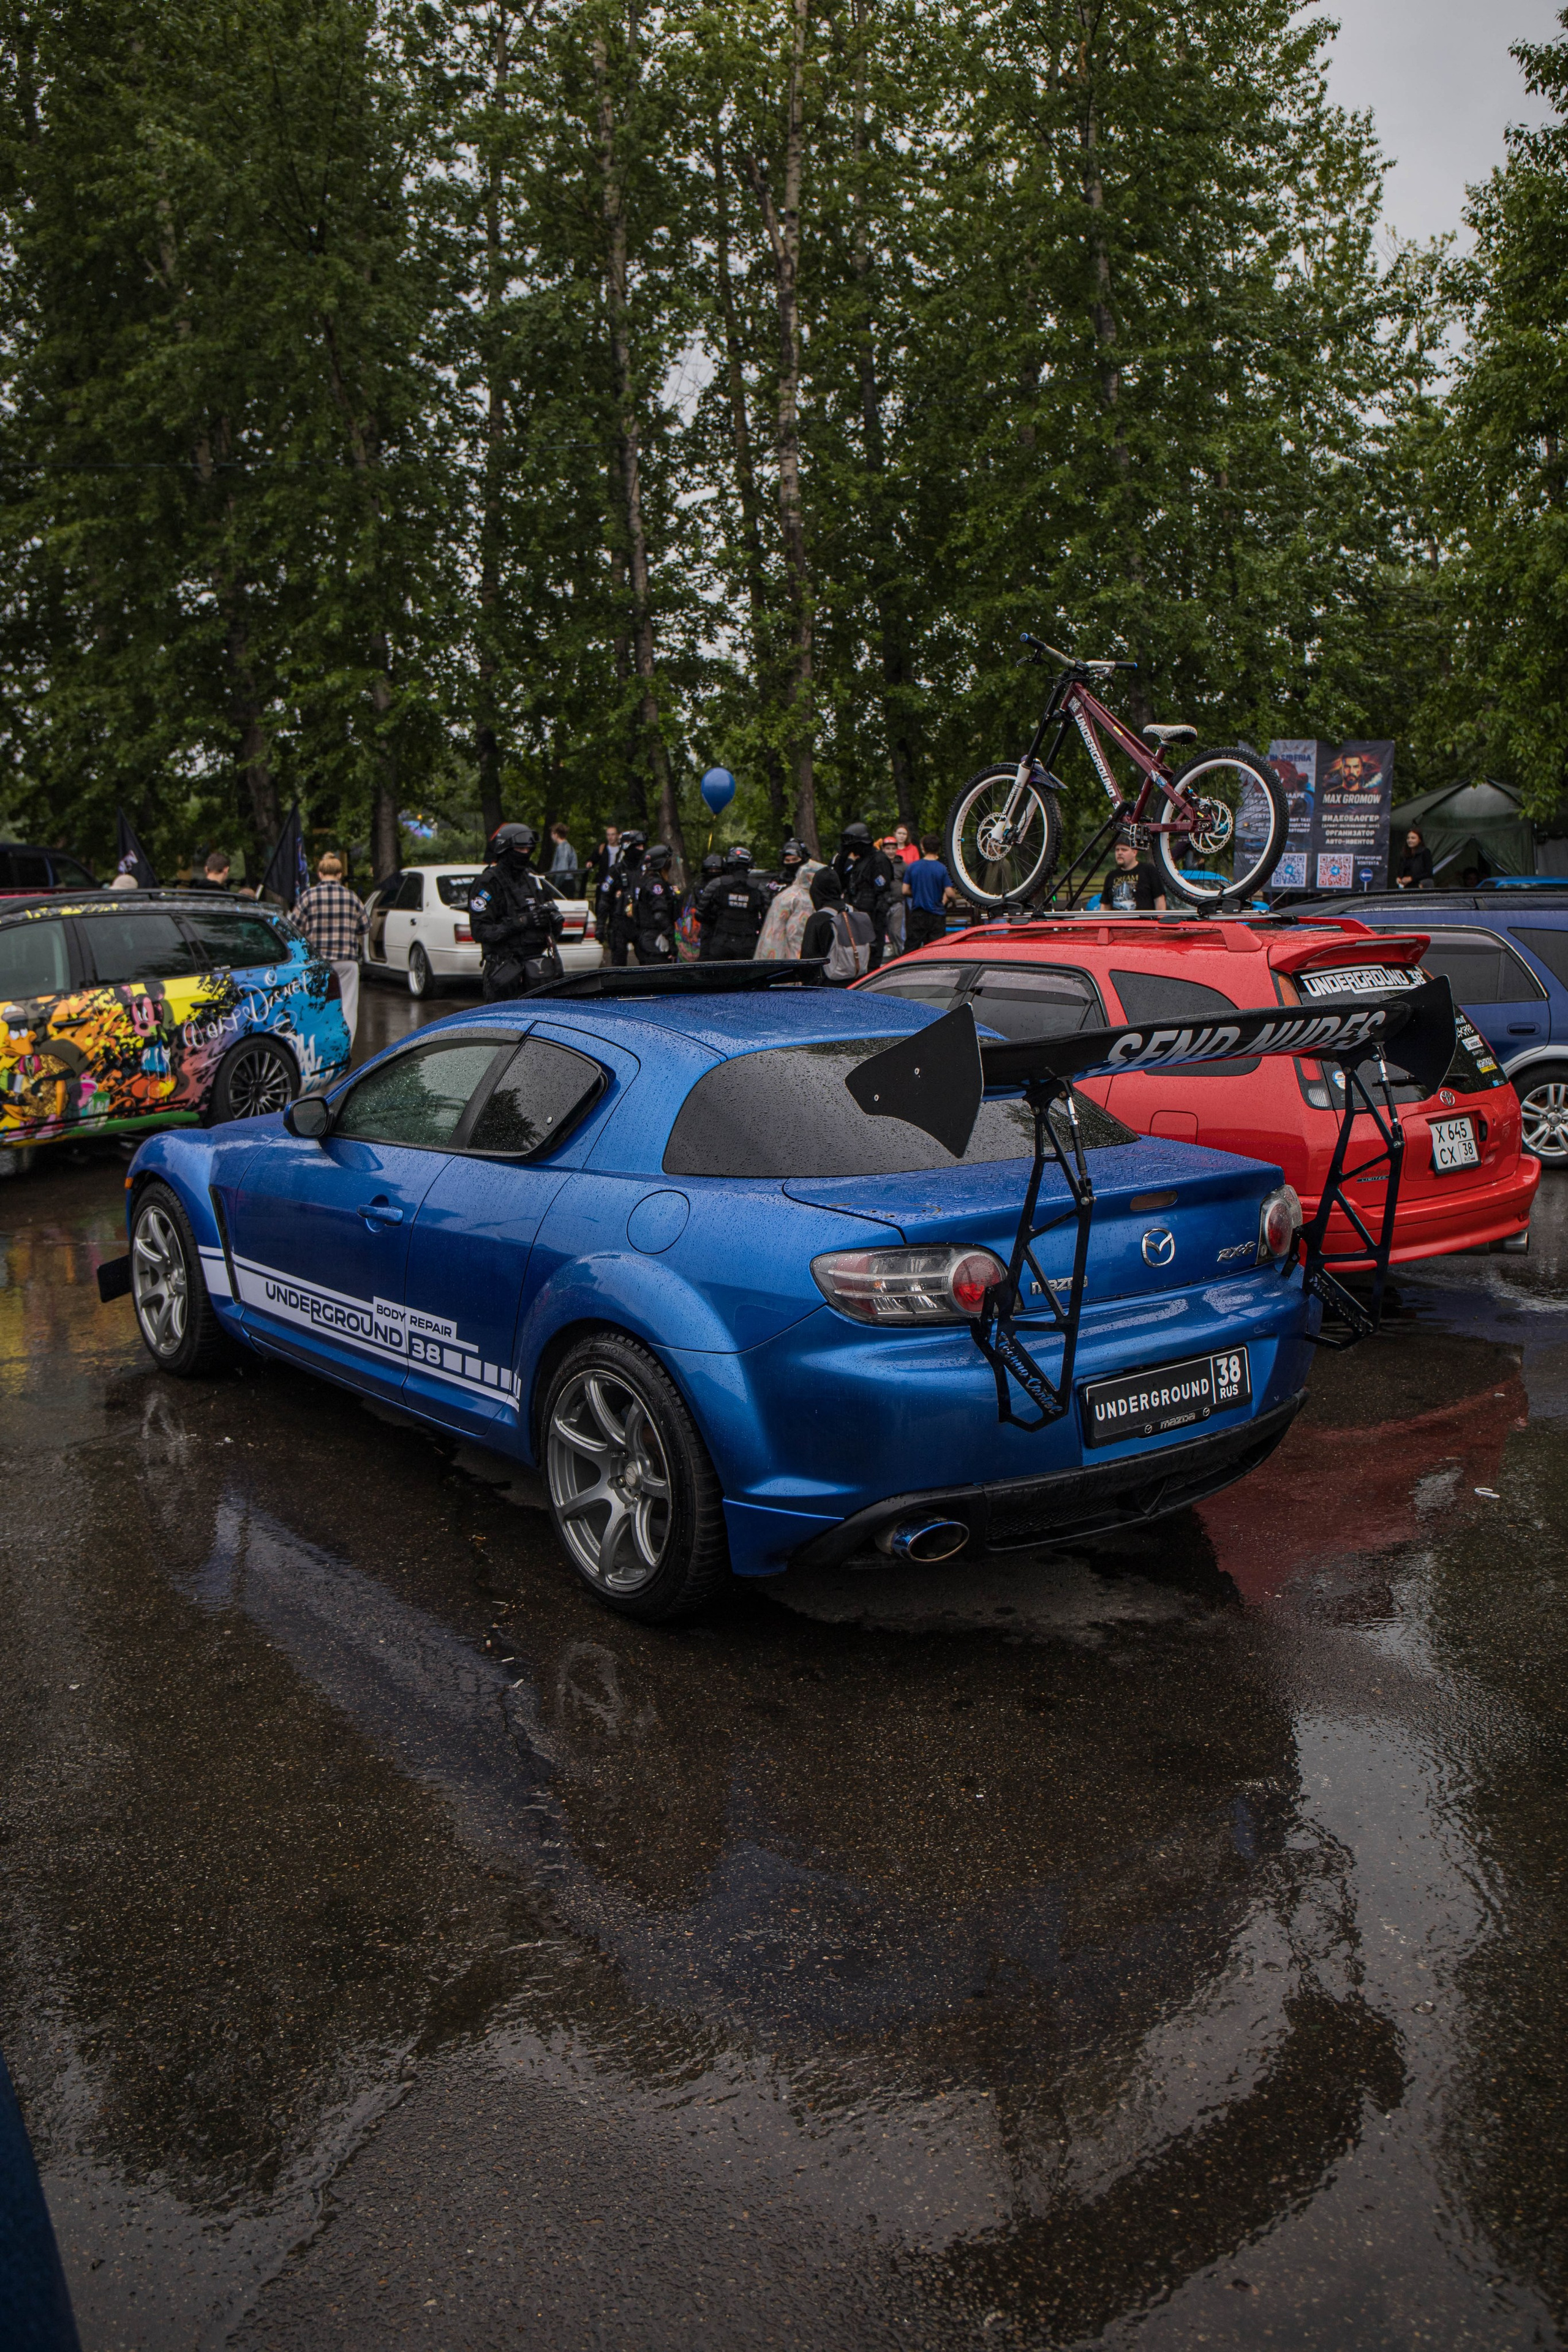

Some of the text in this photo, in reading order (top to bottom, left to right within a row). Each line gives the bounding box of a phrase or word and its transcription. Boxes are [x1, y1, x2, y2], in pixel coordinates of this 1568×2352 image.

[1075, 713, 1117, 798] UNDERGROUND
[1322, 794, 1382, 804] MAX GROMOW
[1303, 969, 1410, 997] UNDERGROUND
[1105, 1011, 1385, 1069] SEND NUDES
[1448, 1121, 1467, 1140] 645
[1462, 1142, 1473, 1156] 38
[1216, 1241, 1256, 1263] RX-8
[266, 1281, 441, 1365] UNDERGROUND 38
[376, 1304, 453, 1338] BODY REPAIR
[1216, 1355, 1241, 1387] 38
[1094, 1378, 1210, 1422] UNDERGROUND
[1219, 1384, 1239, 1400] RUS
[1159, 1412, 1196, 1430] mazda
